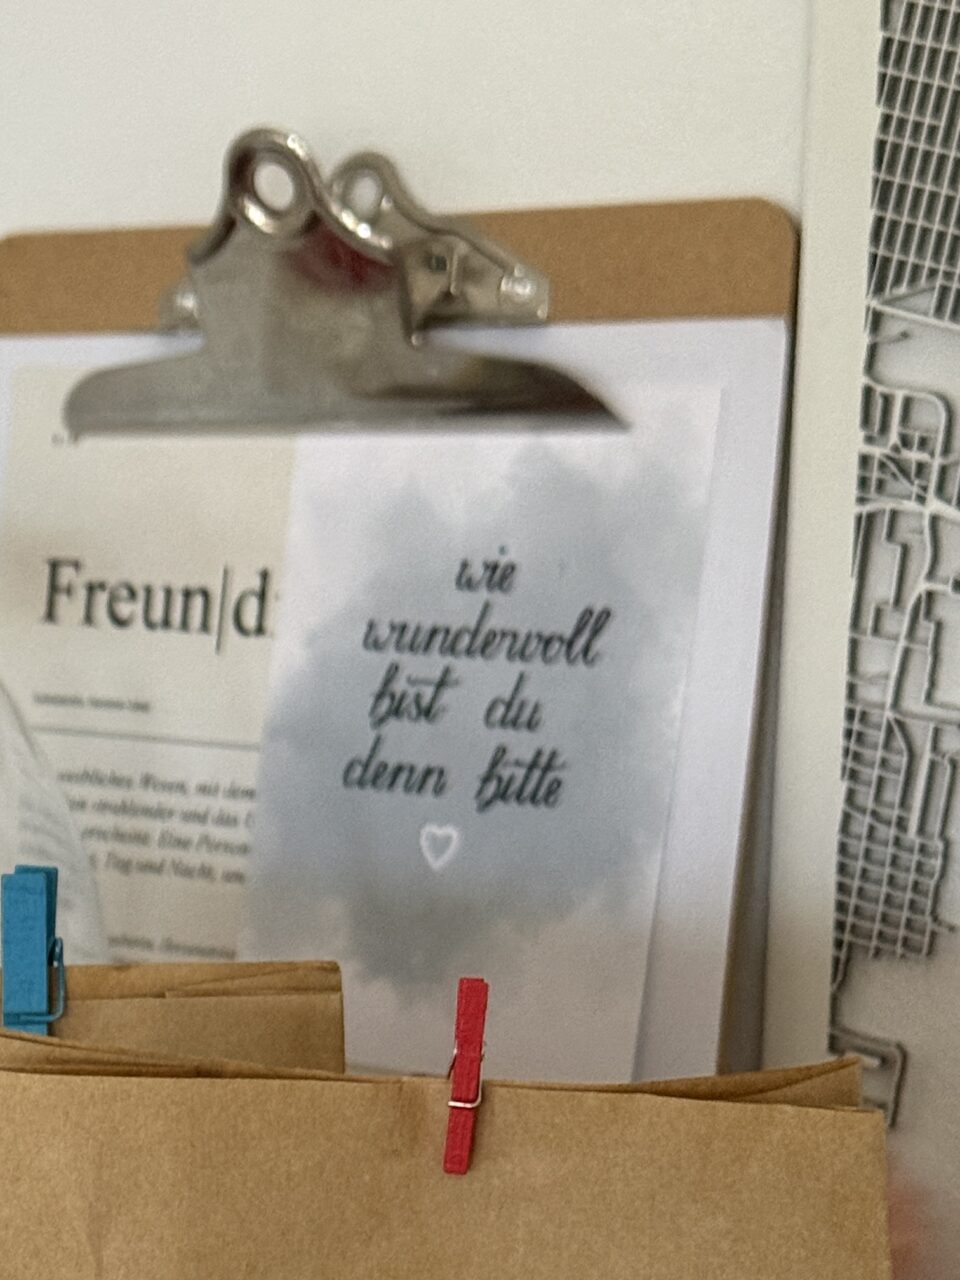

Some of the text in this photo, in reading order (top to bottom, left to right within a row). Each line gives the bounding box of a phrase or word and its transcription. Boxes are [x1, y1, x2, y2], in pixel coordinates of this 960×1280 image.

[455, 545, 517, 593] wie
[44, 557, 279, 655] Freun|d
[362, 600, 612, 667] wundervoll
[369, 662, 544, 733] bist du
[342, 733, 569, 814] denn bitte
